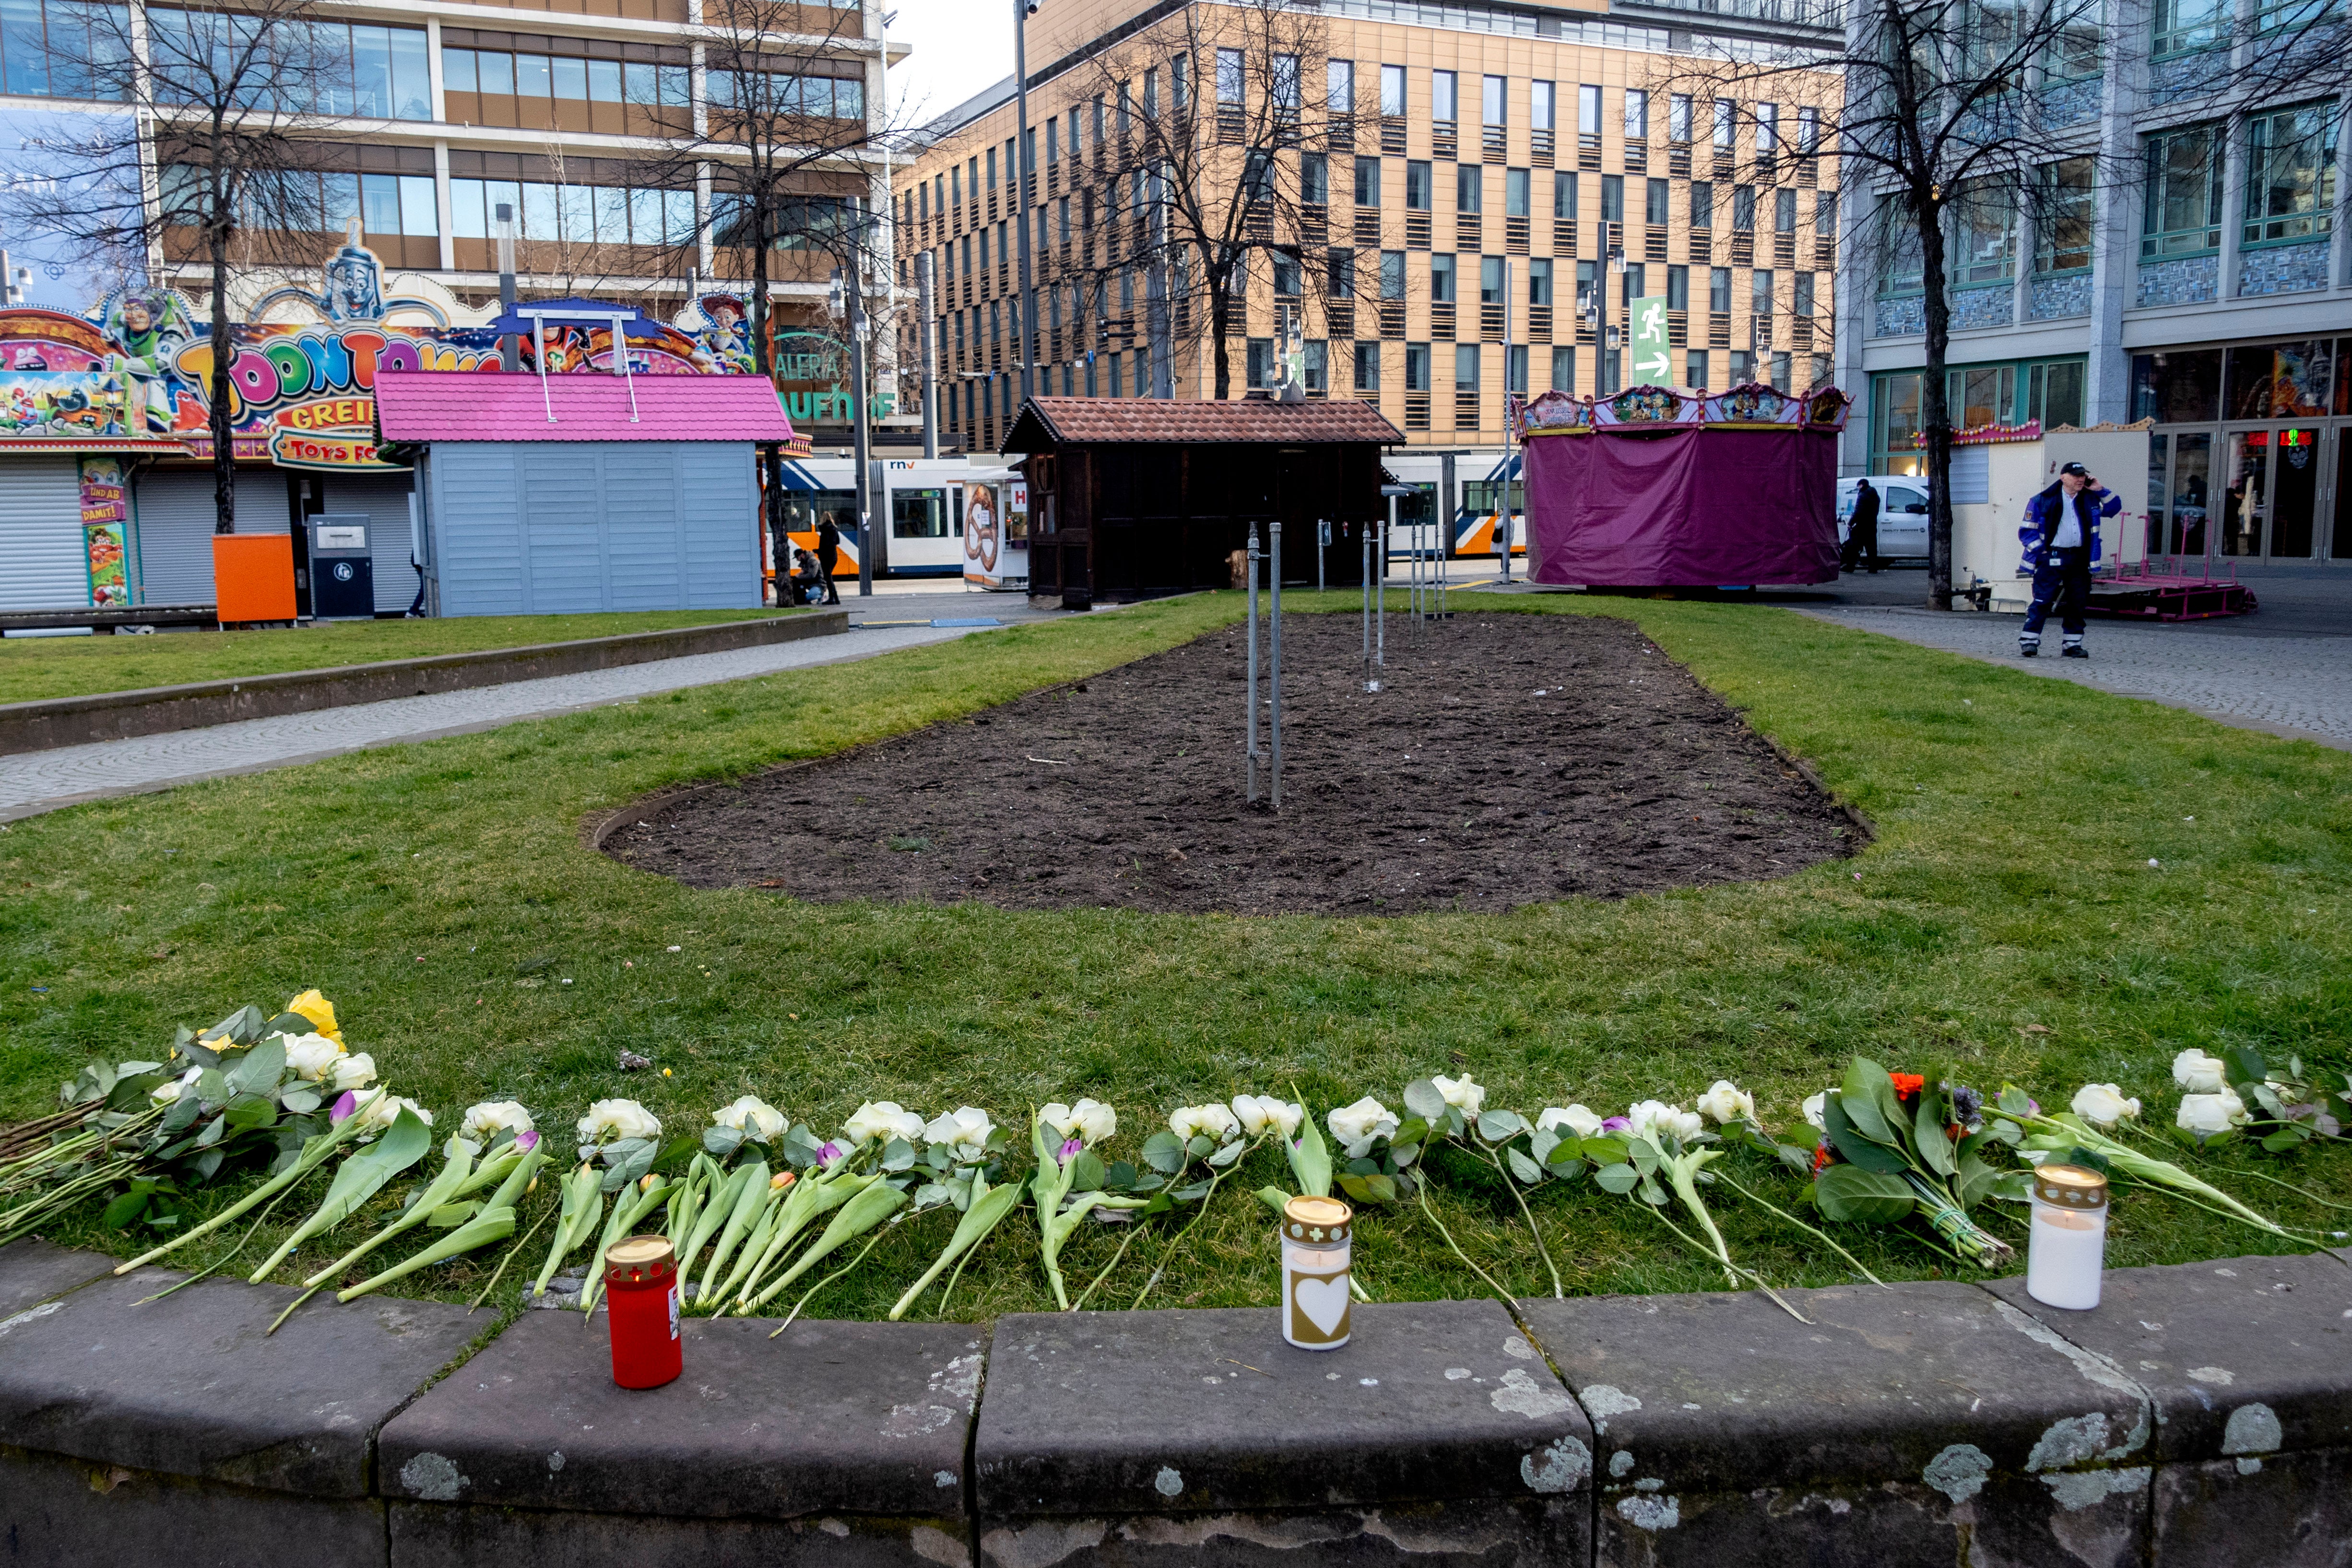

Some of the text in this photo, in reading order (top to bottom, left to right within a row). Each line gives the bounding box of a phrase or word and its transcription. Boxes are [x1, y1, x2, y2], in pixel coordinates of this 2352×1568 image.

[292, 401, 373, 429] GREI
[290, 440, 377, 461] TOYS FO
[890, 461, 915, 469] rnv
[90, 487, 120, 500] UND AB
[82, 505, 116, 521] DAMIT!
